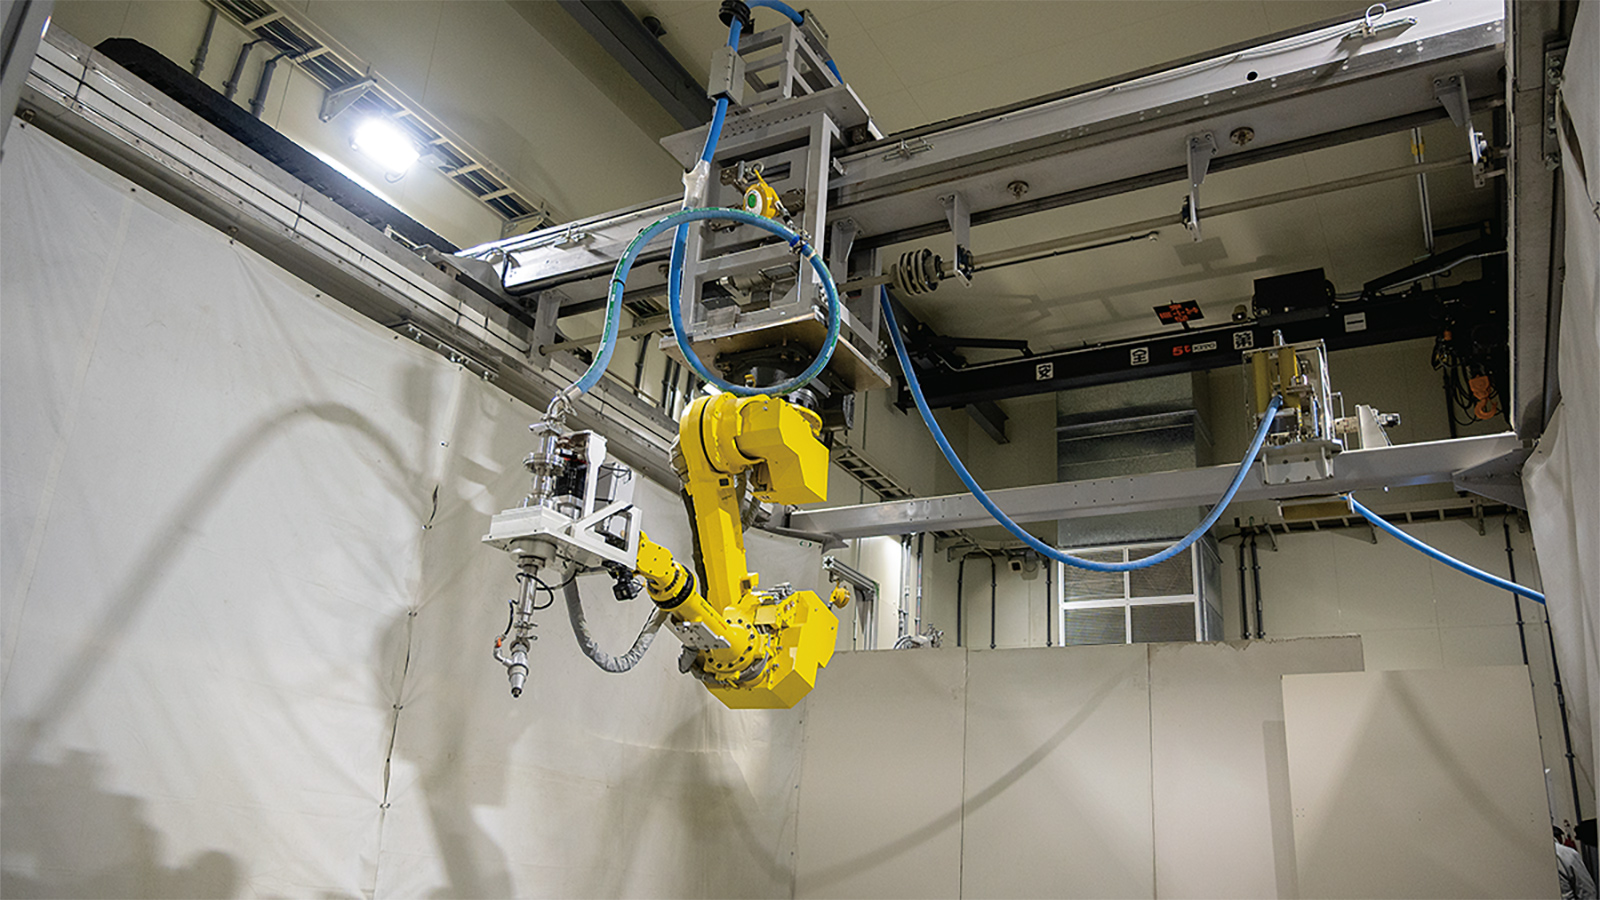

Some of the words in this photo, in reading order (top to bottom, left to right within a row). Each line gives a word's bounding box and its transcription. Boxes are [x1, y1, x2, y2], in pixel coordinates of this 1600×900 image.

[1172, 344, 1192, 357] 5t
[1038, 364, 1051, 379] 安
[1132, 348, 1147, 364] 全
